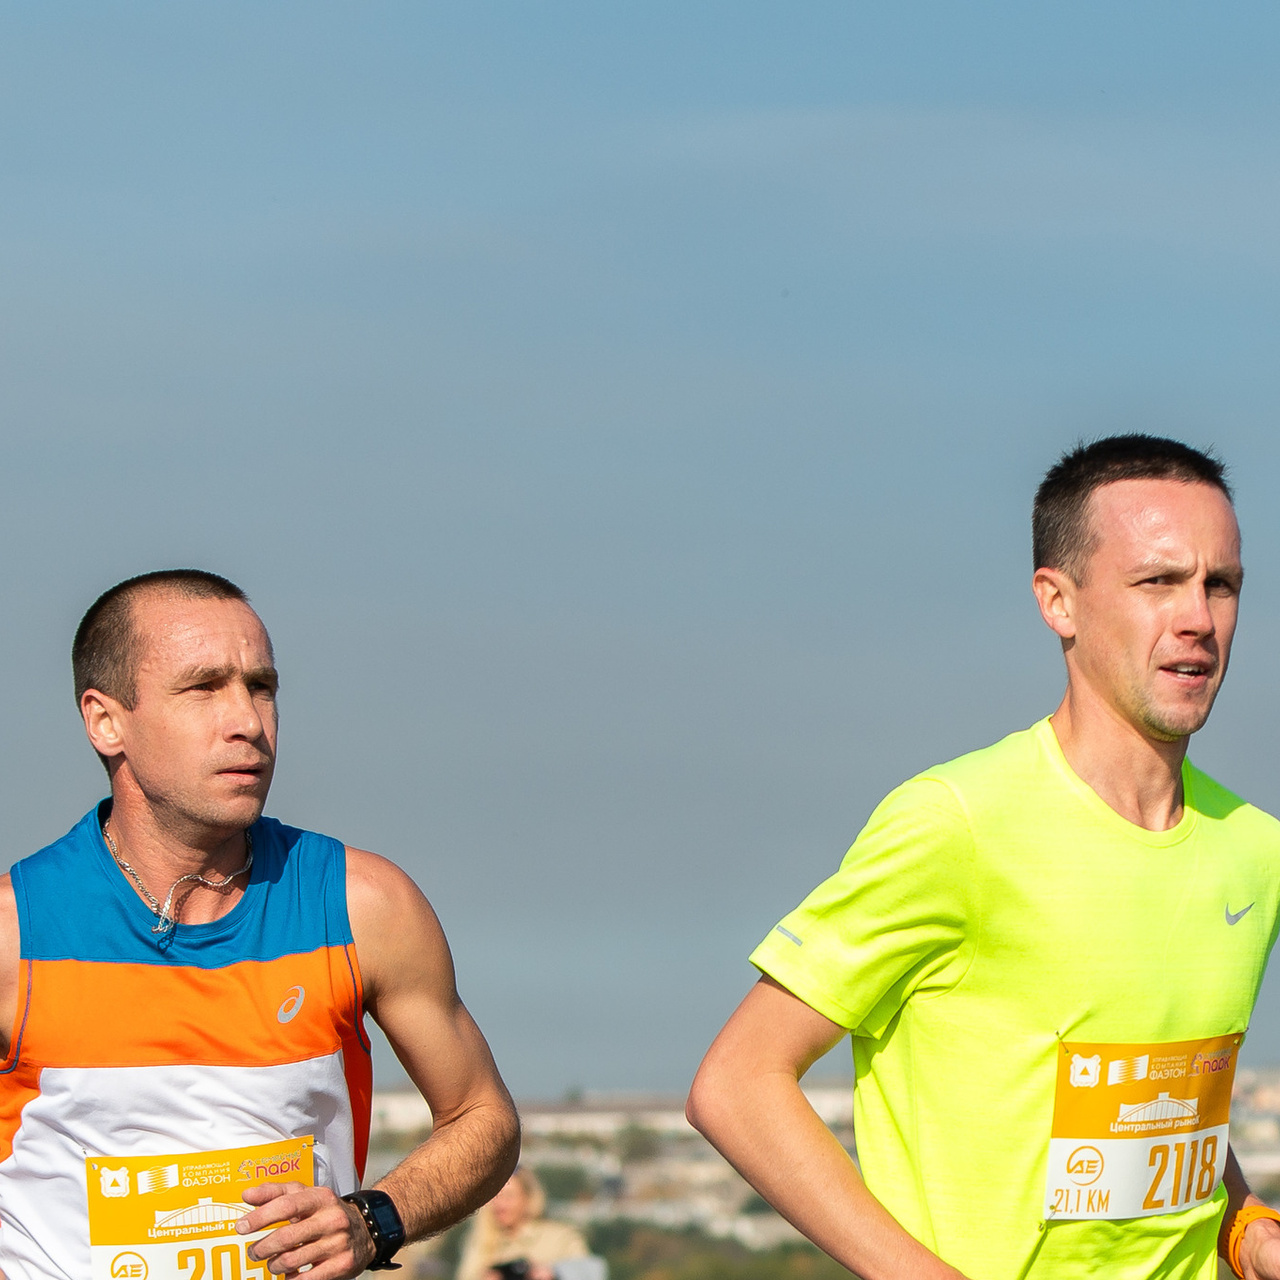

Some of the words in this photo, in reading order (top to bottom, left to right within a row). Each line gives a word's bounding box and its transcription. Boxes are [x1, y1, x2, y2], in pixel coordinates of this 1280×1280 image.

[1149, 1067, 1187, 1081] ФАЭТОН
[1109, 1118, 1173, 1134] Центральный
[182, 1167, 231, 1178] КОМПАНИЯ
[182, 1174, 231, 1187] ФАЭТОН
[1142, 1135, 1218, 1210] 2118
[1054, 1188, 1082, 1215] 21,1
[147, 1221, 226, 1239] Центральный
